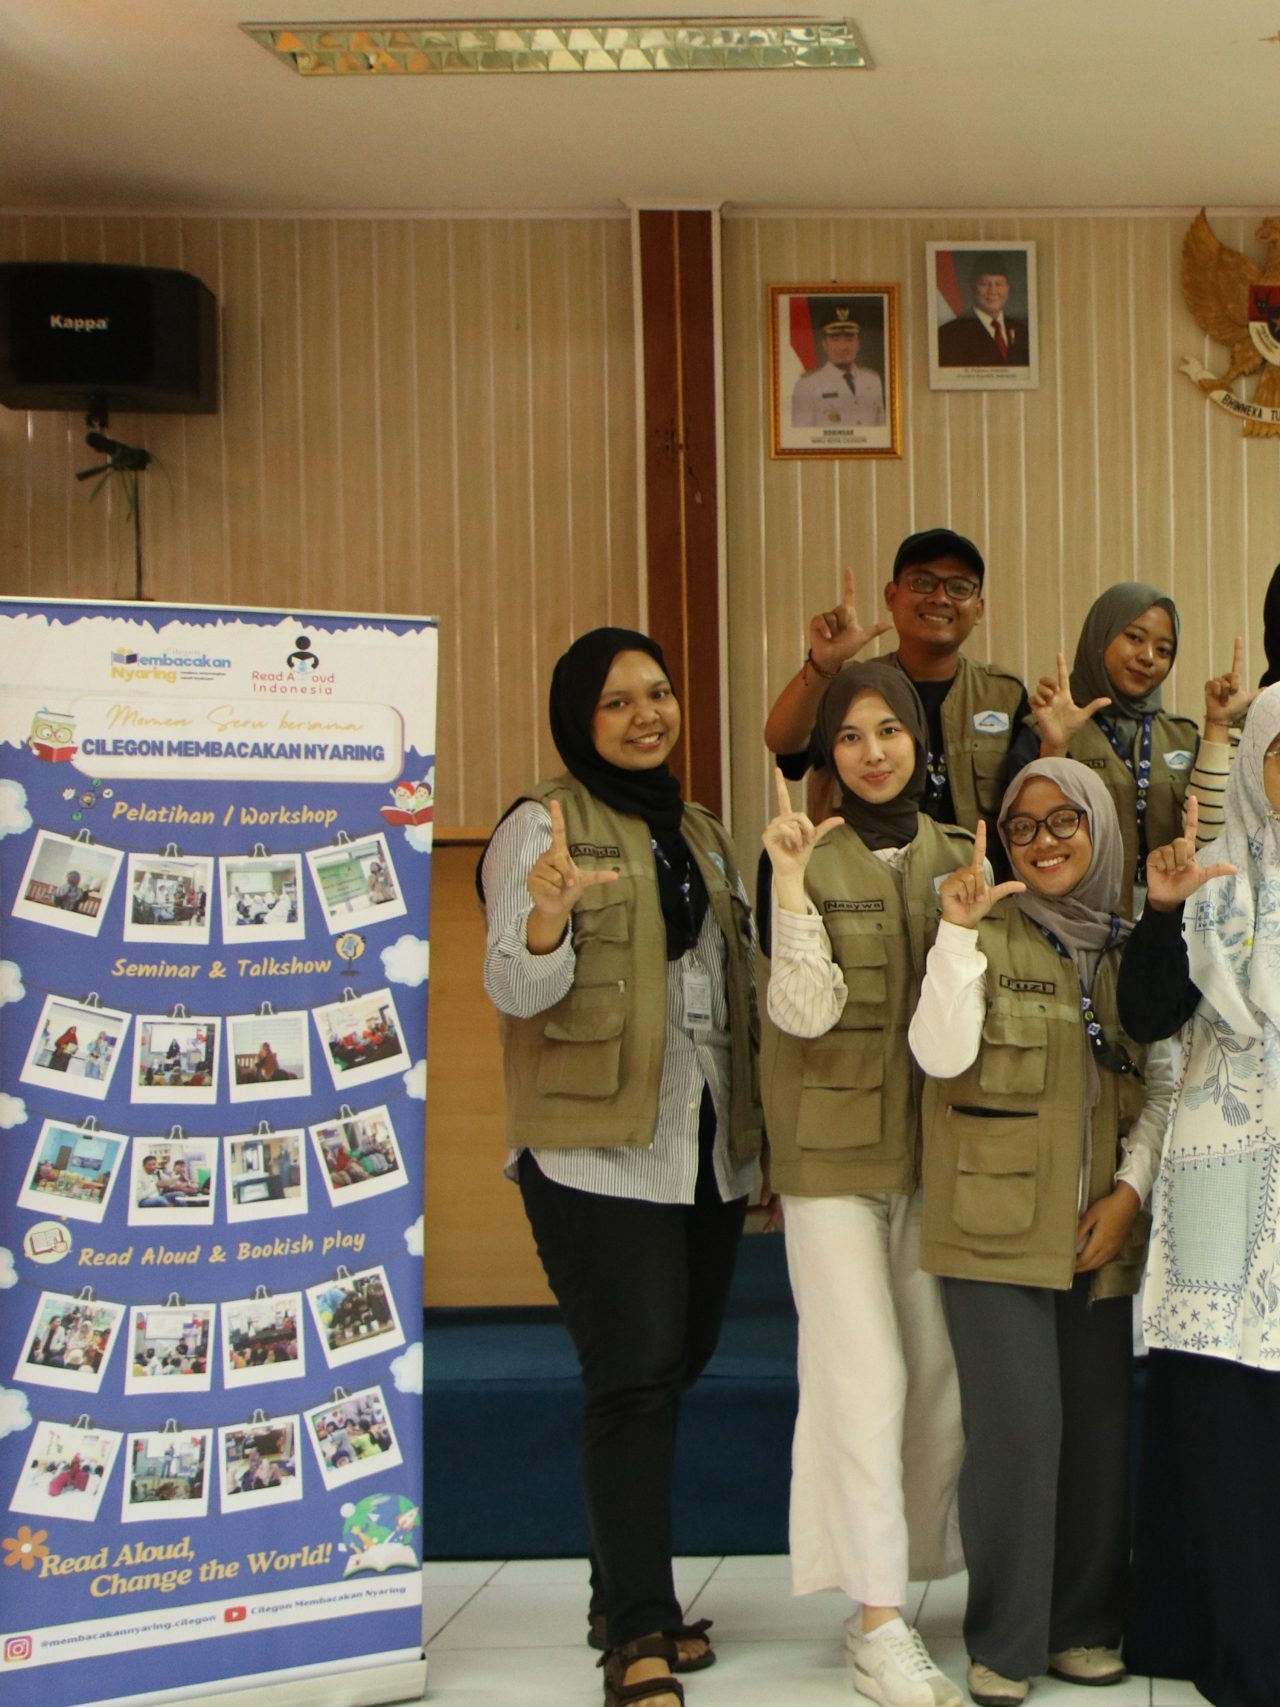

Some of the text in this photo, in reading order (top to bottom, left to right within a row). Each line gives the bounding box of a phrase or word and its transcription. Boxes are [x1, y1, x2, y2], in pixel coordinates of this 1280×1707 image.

[50, 314, 108, 333] Kappa
[110, 666, 177, 684] Nyaring
[251, 670, 283, 682] Read
[252, 682, 333, 695] Indonesia
[81, 738, 385, 762] CILEGON MEMBACAKAN NYARING
[112, 801, 215, 826] Pelatihan
[240, 804, 338, 828] Workshop
[111, 956, 333, 979] Seminar & Talkshow
[78, 1230, 366, 1267] Read Aloud & Bookish play
[38, 1536, 196, 1579] Read Aloud,
[89, 1543, 333, 1599] Change the World!
[365, 1586, 407, 1599] Nyaring
